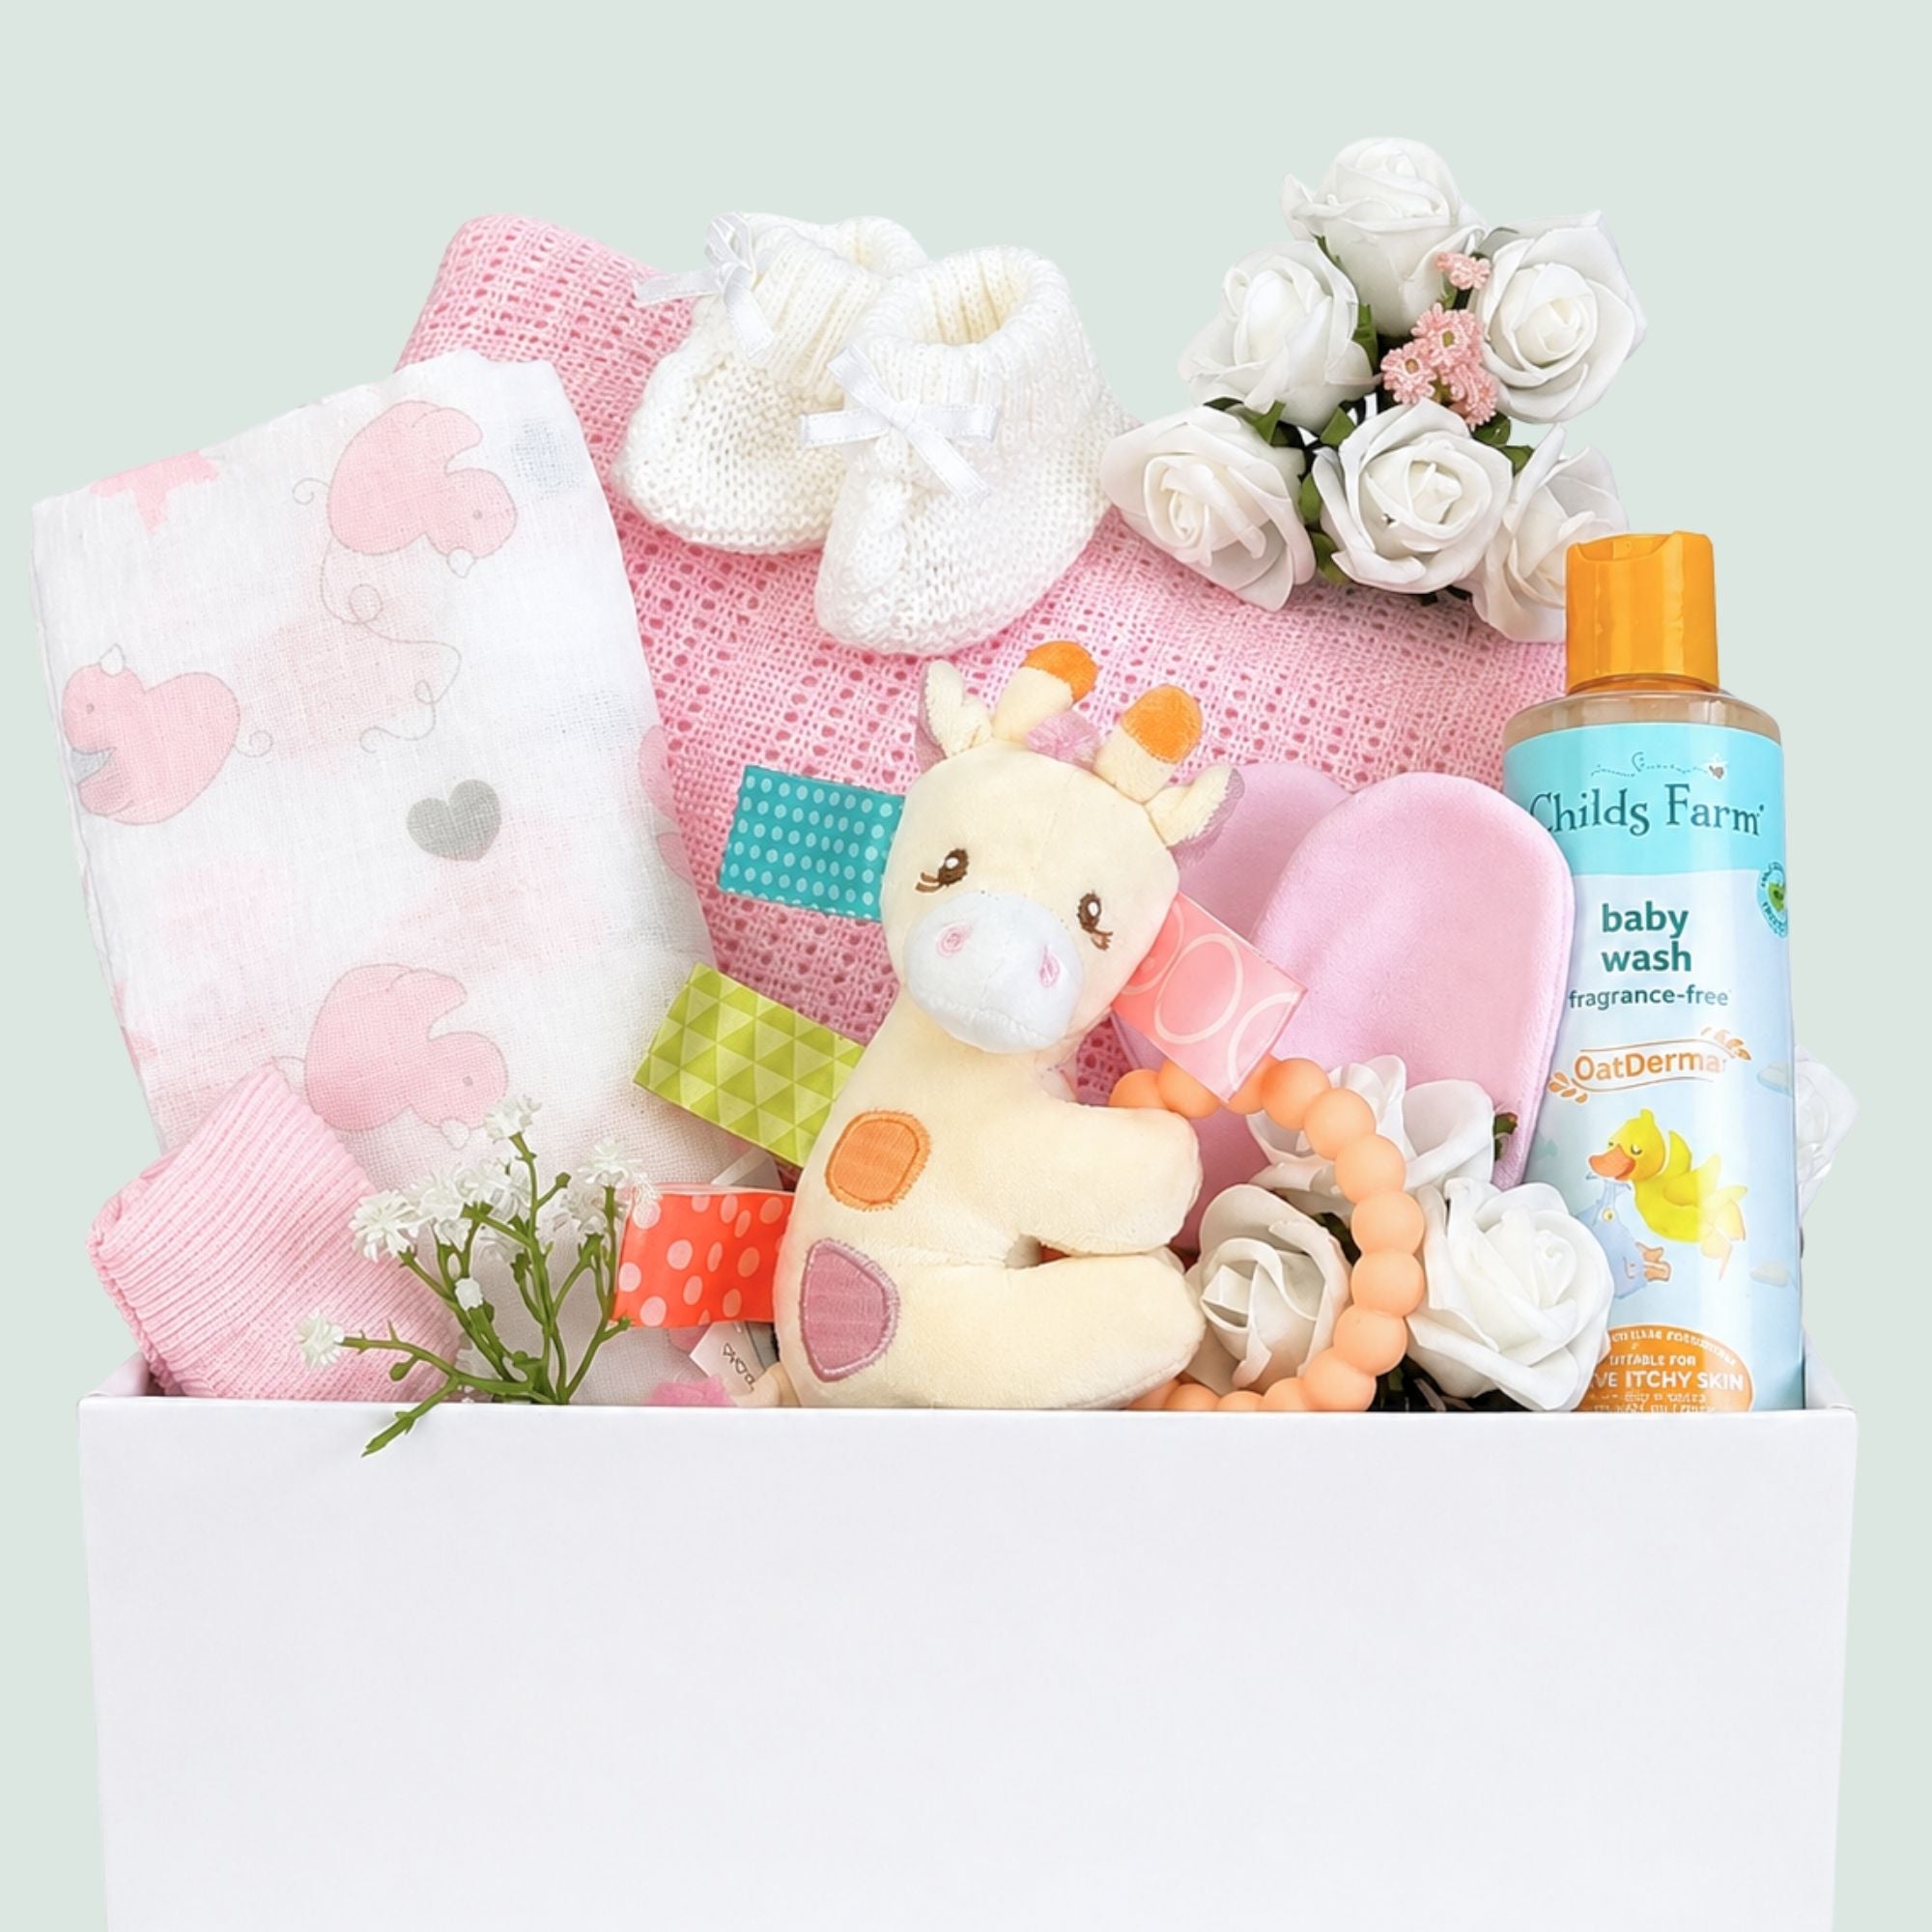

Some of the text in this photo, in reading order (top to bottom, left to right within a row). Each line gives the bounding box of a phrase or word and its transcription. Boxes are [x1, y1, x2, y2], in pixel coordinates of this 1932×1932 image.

[1529, 783, 1760, 837] Childs Farm
[1602, 901, 1689, 939] baby
[1601, 941, 1691, 972] wash
[1569, 984, 1729, 1010] fragrance-free
[1575, 1052, 1721, 1081] OatDerma
[1609, 1355, 1665, 1366] UITABLE
[1625, 1370, 1692, 1388] ITCHY
[1696, 1372, 1744, 1390] SKIN
